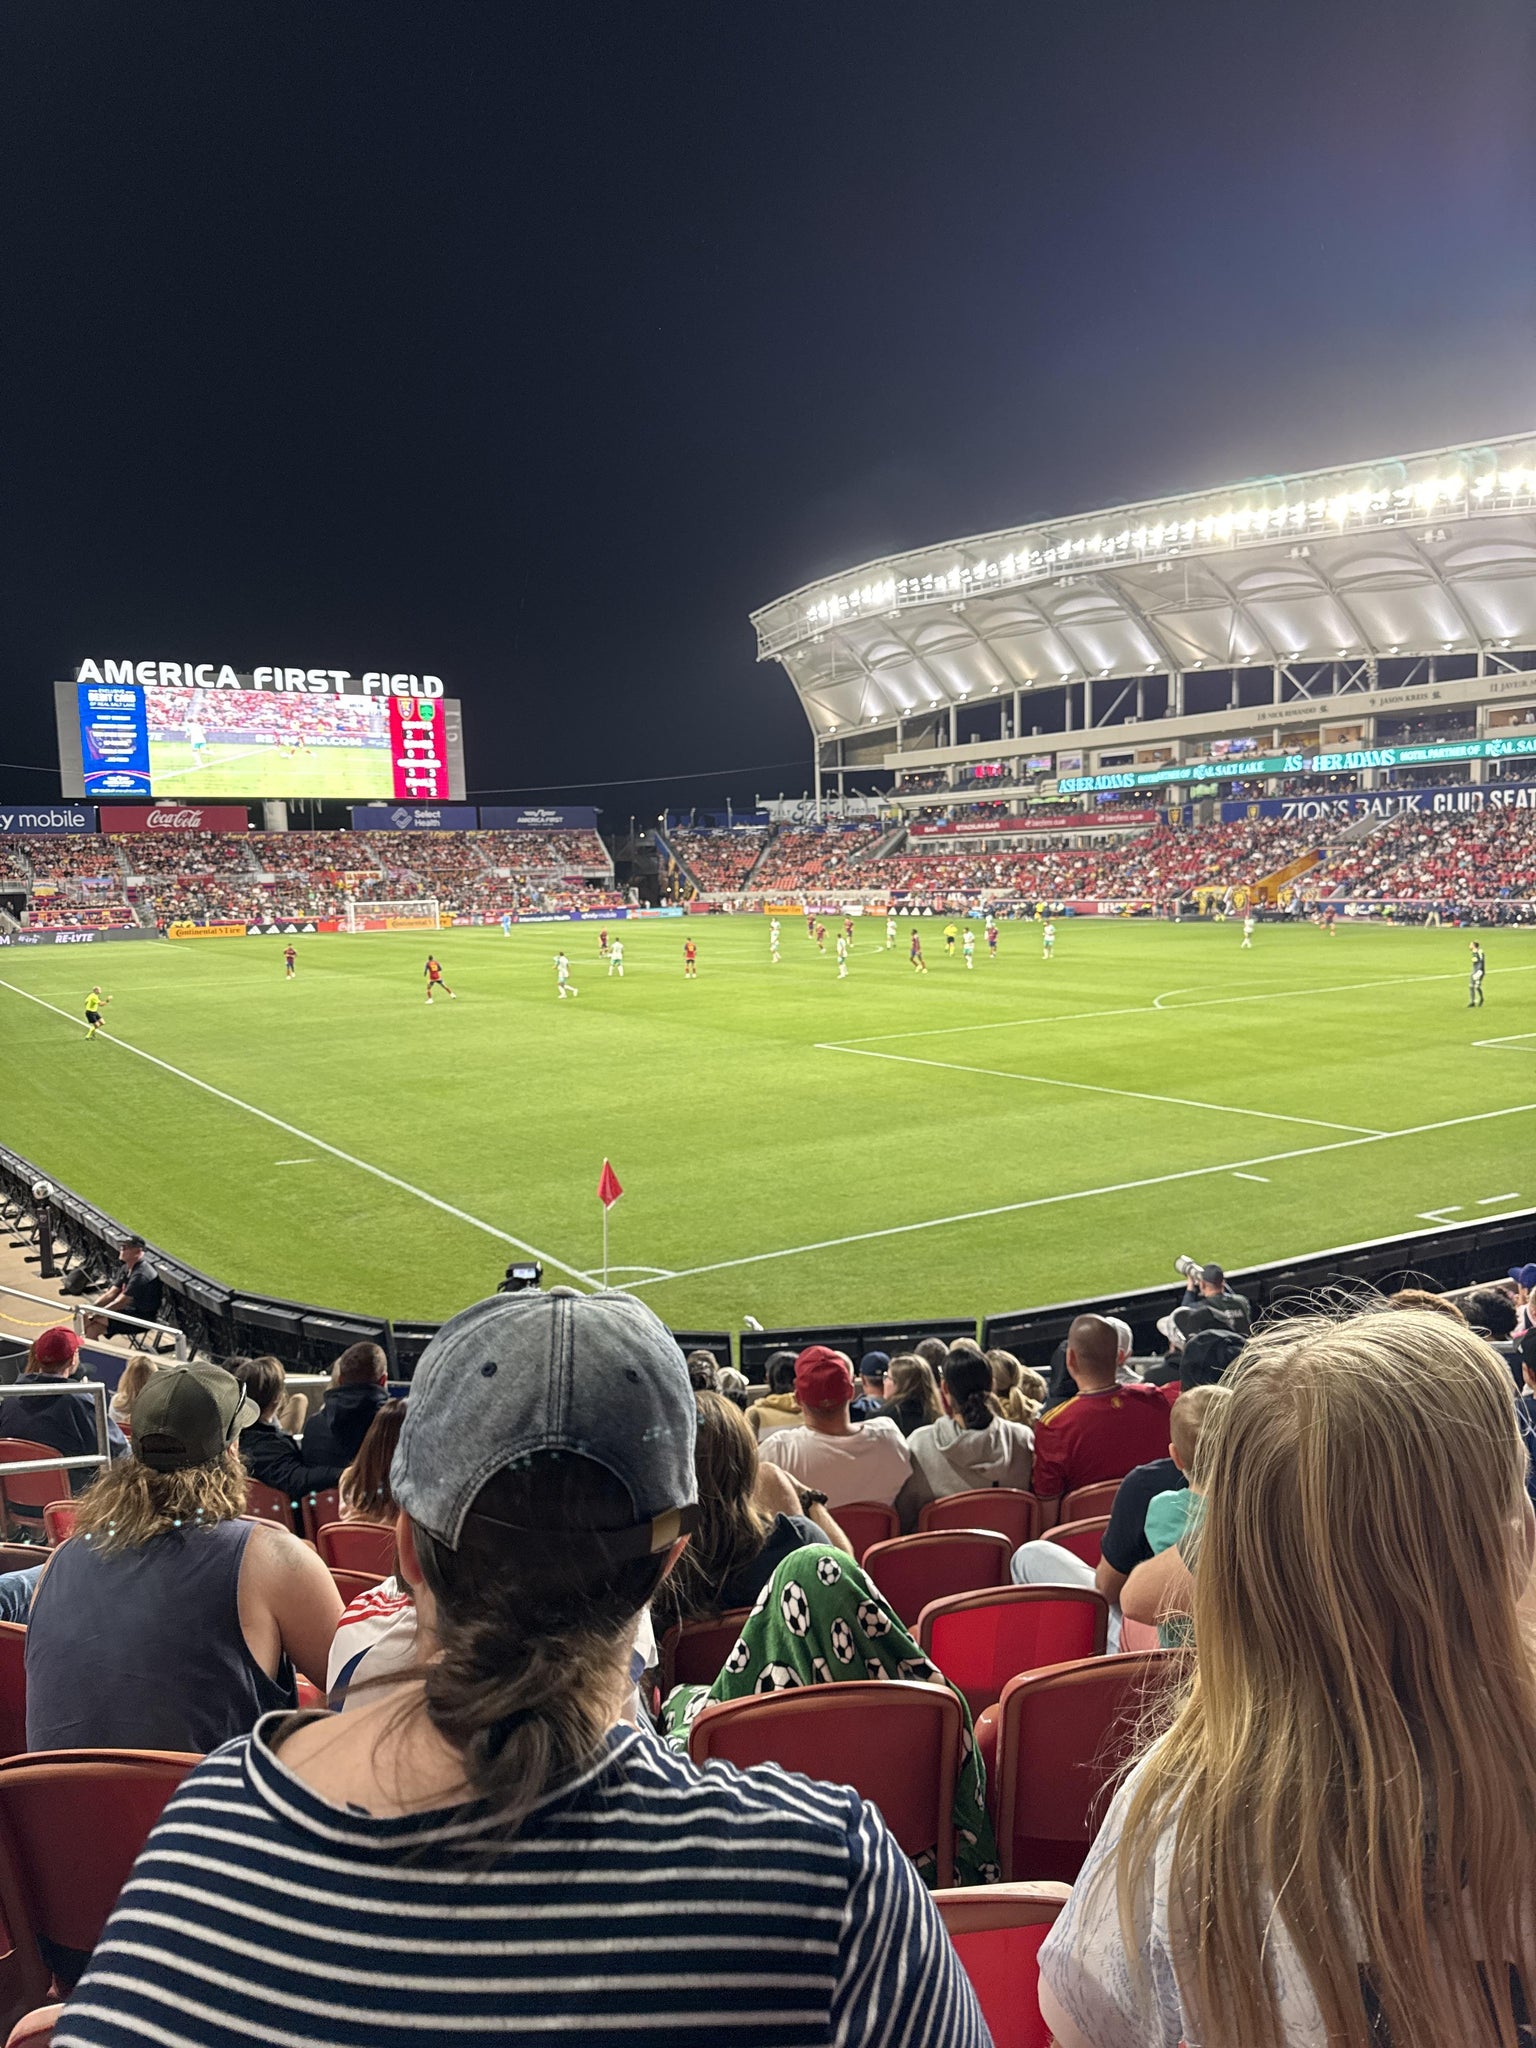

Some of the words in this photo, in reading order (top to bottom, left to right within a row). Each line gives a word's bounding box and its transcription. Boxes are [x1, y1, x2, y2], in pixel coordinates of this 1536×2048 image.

[77, 658, 241, 689] AMERICA
[253, 666, 351, 693] FIRST
[362, 672, 444, 698] FIELD
[1380, 695, 1403, 706] JASON
[1405, 692, 1428, 701] KREIS
[1344, 748, 1395, 769] ADAMS
[1467, 744, 1482, 756] OF
[1058, 776, 1094, 793] ASHER
[1095, 772, 1136, 789] ADAMS
[1215, 764, 1238, 776] SALT
[1239, 761, 1265, 774] LAKE
[414, 810, 441, 818] Select
[1281, 798, 1349, 821] ZIONS
[19, 811, 86, 827] mobile
[414, 819, 441, 827] Health
[516, 816, 545, 824] AMERICA
[546, 815, 564, 823] FIRST
[55, 933, 95, 944] RE-LYTE
[175, 928, 217, 937] Continental
